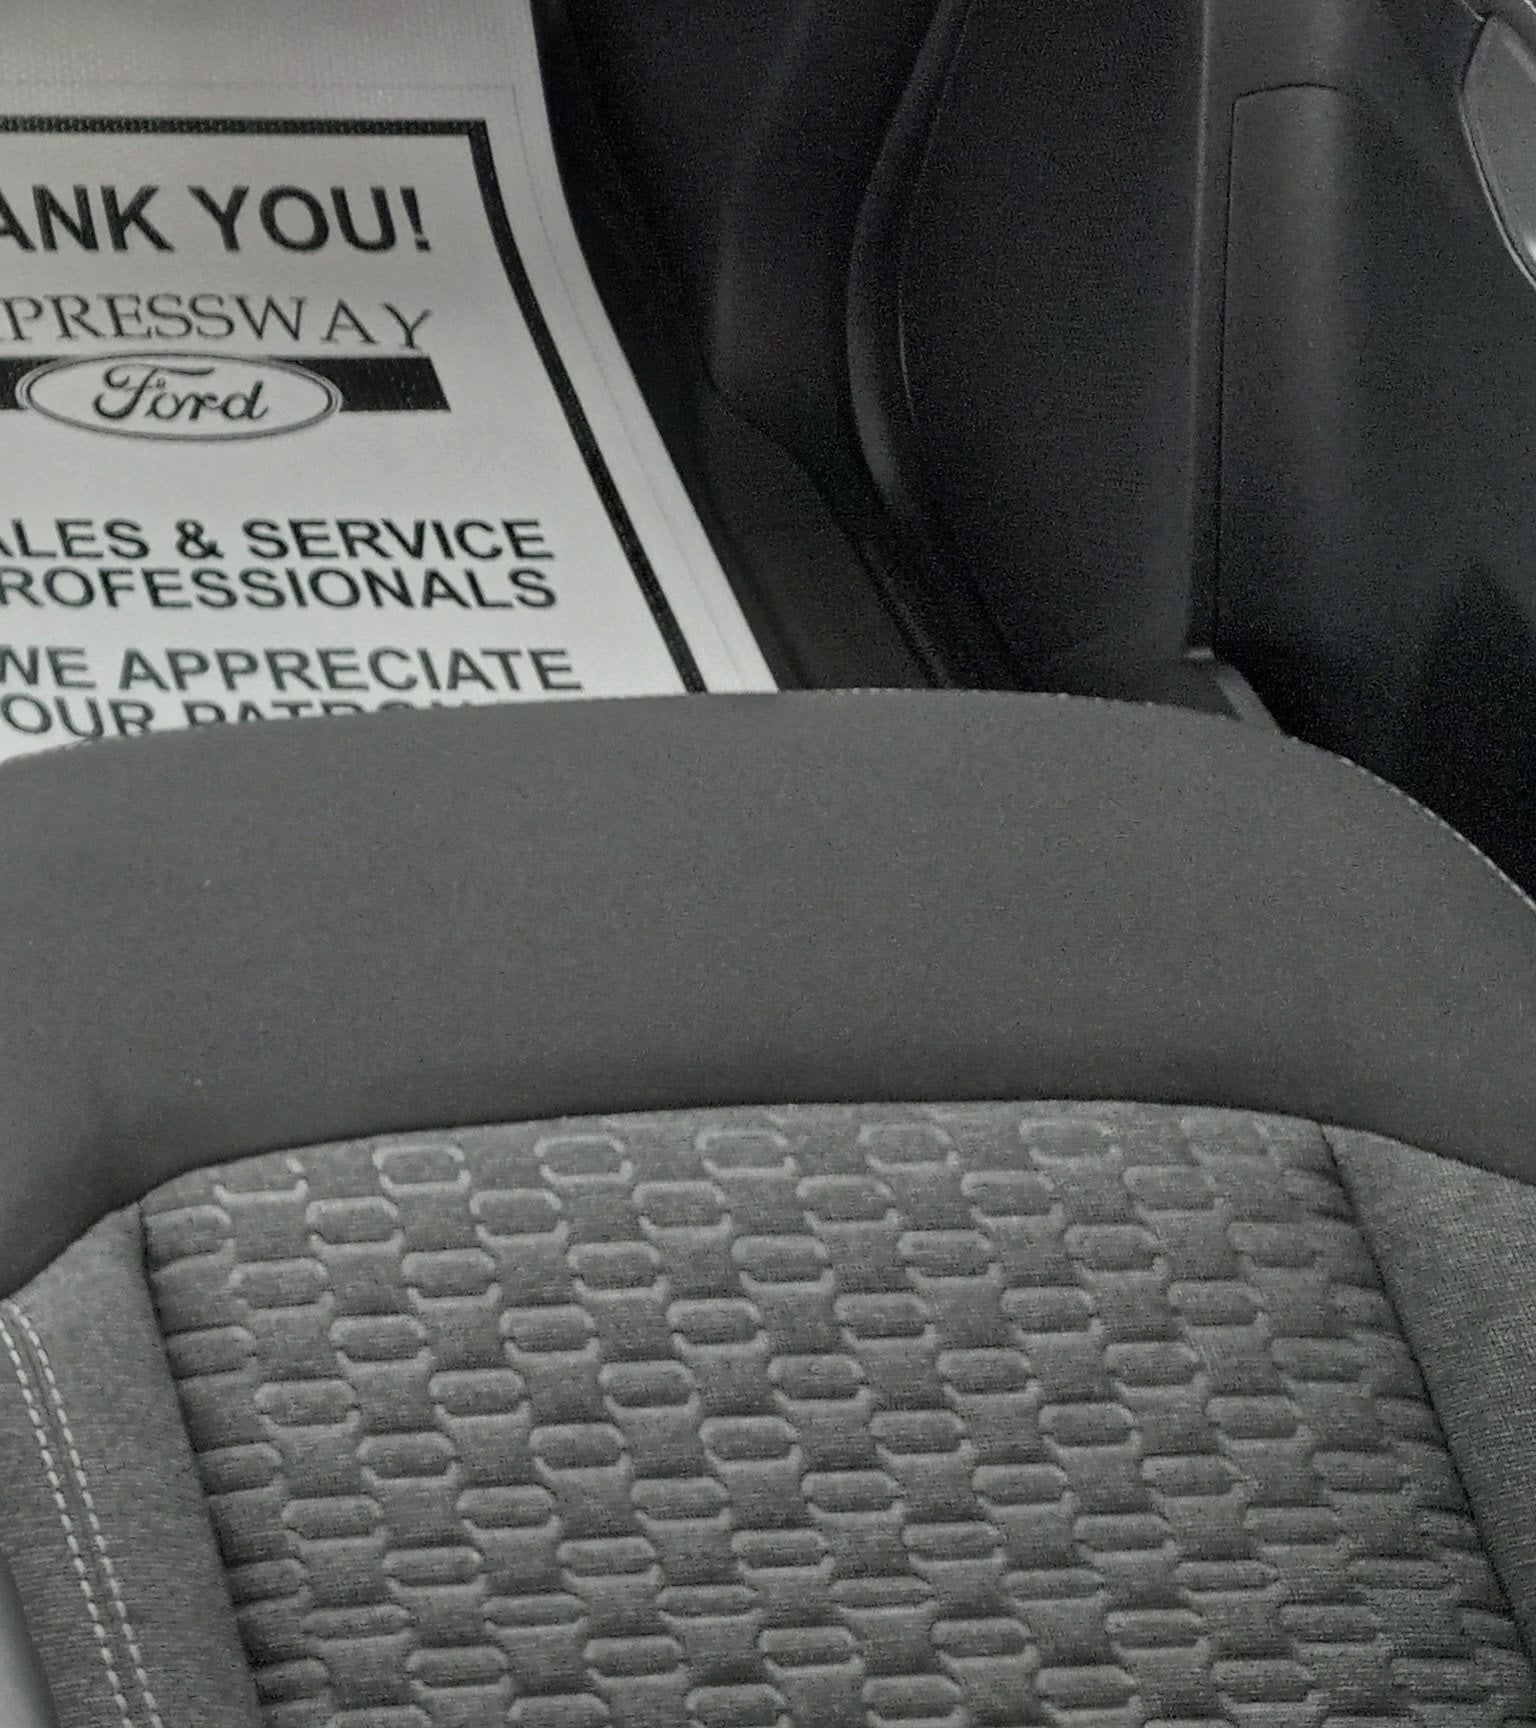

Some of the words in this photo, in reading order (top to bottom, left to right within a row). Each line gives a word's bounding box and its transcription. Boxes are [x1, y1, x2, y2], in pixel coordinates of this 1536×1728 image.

[187, 183, 435, 254] YOU!
[92, 362, 270, 425] Ford
[175, 518, 227, 561] &
[241, 518, 556, 561] SERVICE
[117, 645, 583, 693] APPRECIATE
